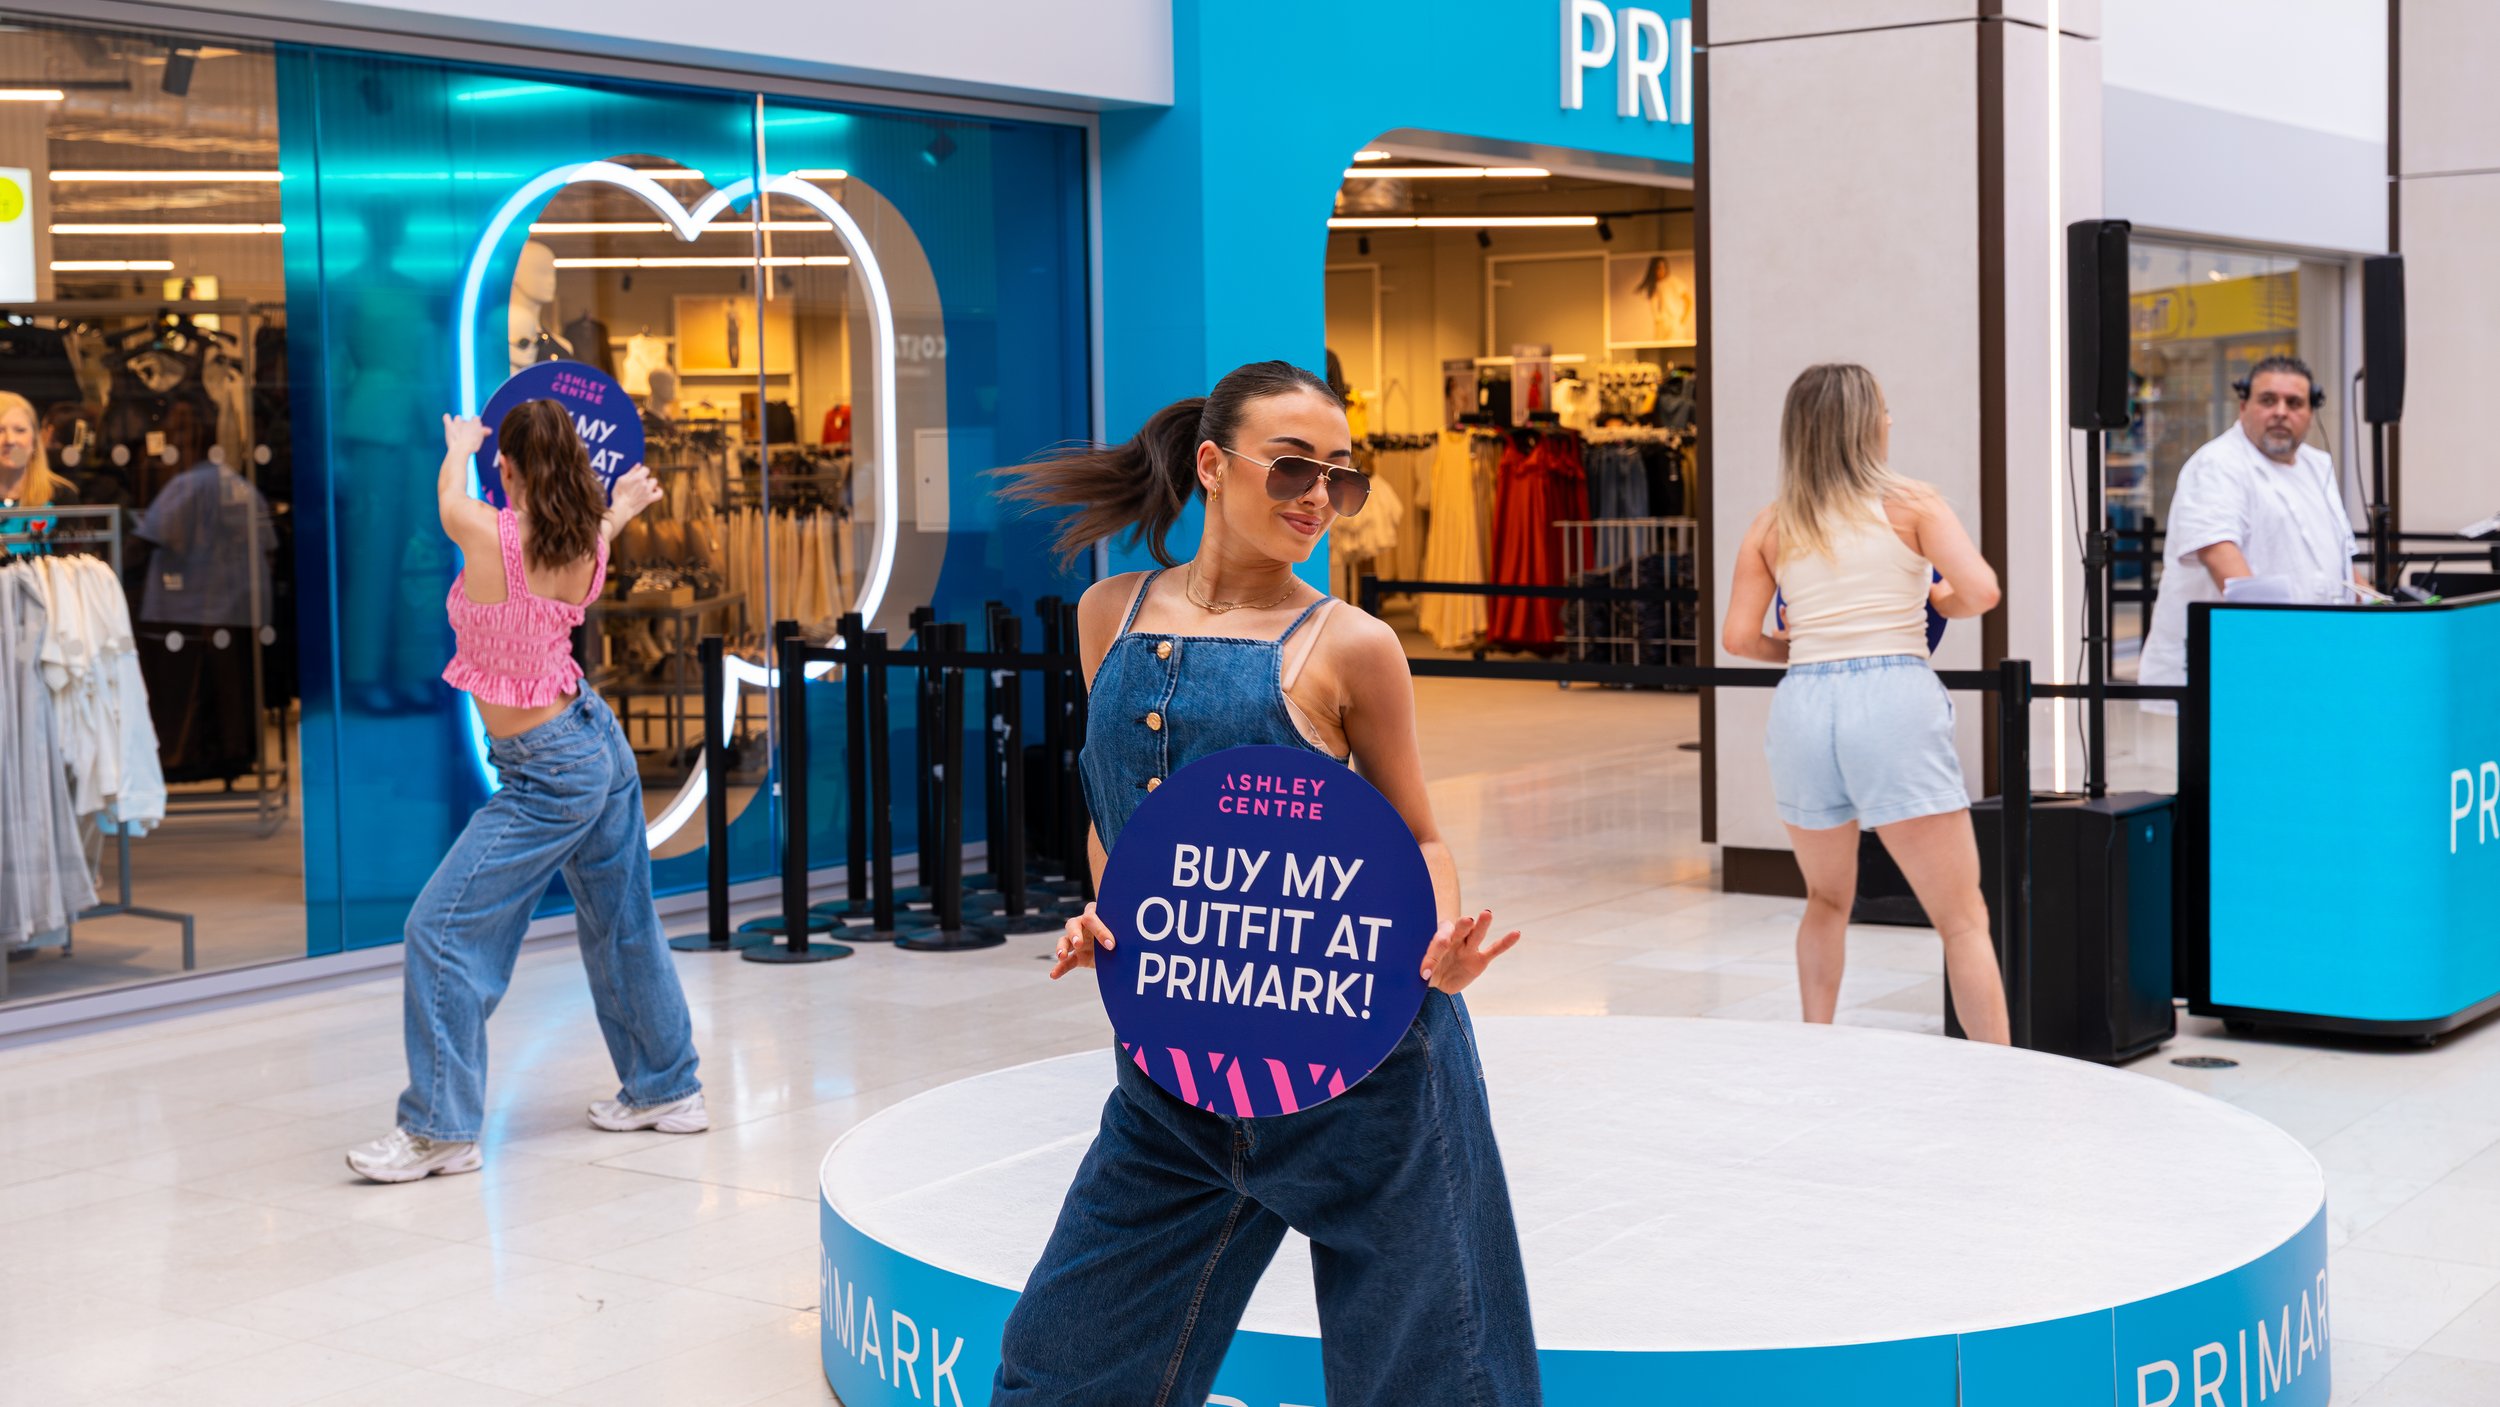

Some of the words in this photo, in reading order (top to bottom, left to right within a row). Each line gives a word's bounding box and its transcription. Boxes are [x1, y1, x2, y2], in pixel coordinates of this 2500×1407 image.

[1560, 0, 1692, 125] PRI
[551, 382, 604, 405] CENTRE
[554, 371, 607, 393] ASHLEY
[589, 448, 624, 474] AT
[1220, 773, 1326, 797] ASHLEY
[1218, 796, 1323, 820] CENTRE
[1172, 843, 1271, 893] BUY
[1282, 852, 1364, 901] MY
[1136, 896, 1315, 954] OUTFIT
[1324, 914, 1393, 962] AT
[1136, 951, 1375, 1020] PRIMARK!
